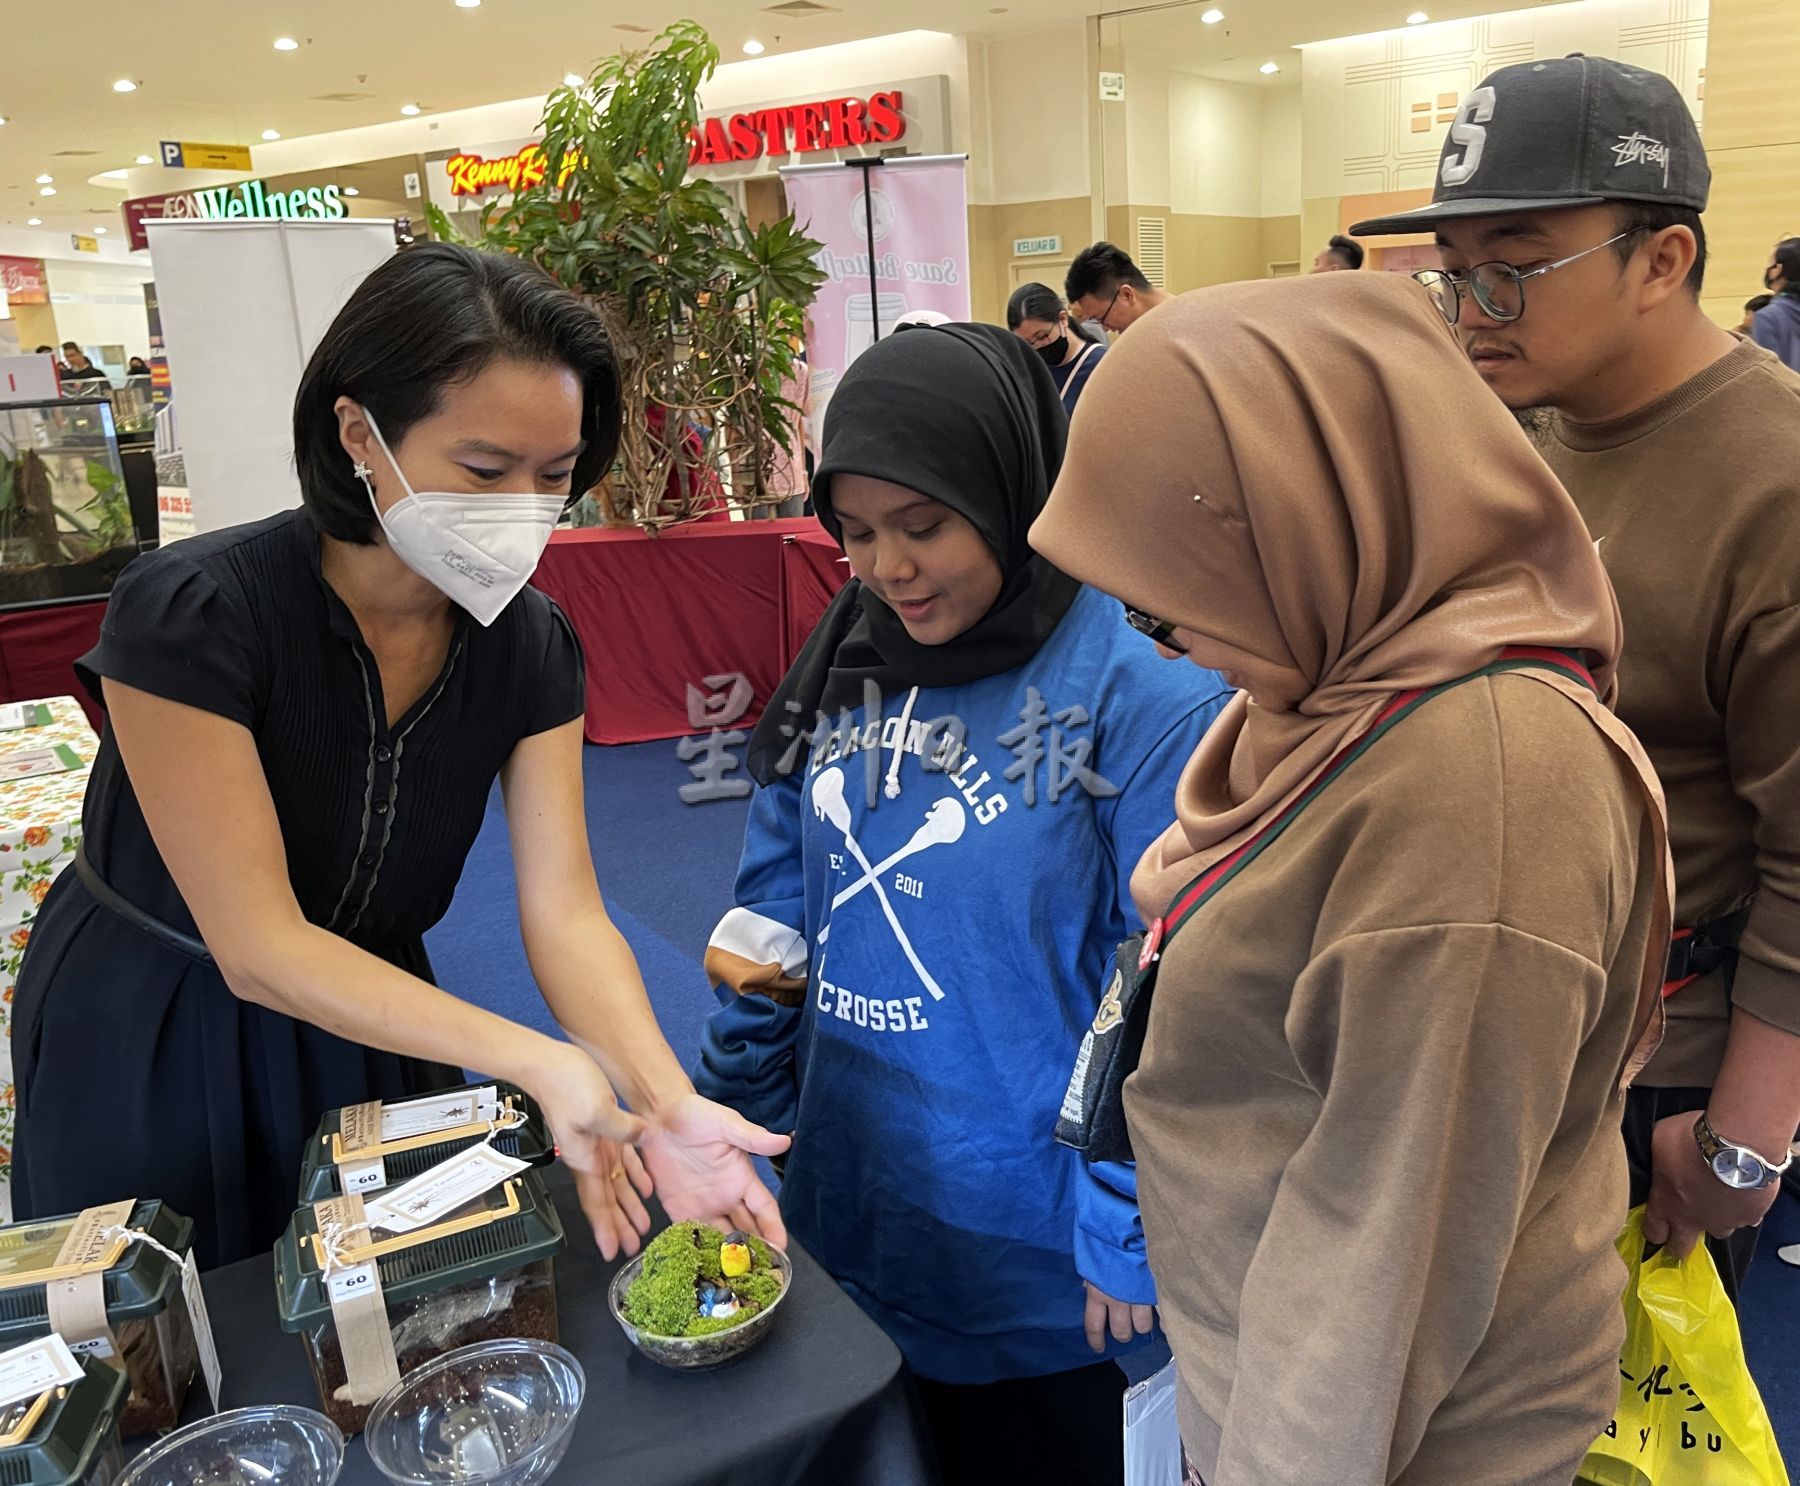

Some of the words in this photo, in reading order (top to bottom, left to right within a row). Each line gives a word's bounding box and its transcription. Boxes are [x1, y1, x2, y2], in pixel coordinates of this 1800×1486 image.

[687, 90, 906, 167] ASTERS
[1441, 86, 1497, 188] S
[164, 144, 179, 165] P
[448, 155, 522, 194] Kenny
[195, 179, 345, 219] Wellness
[895, 873, 924, 899] 2011
[817, 979, 929, 1032] CROSSE
[358, 1174, 377, 1184] 60
[346, 1275, 367, 1287] 60
